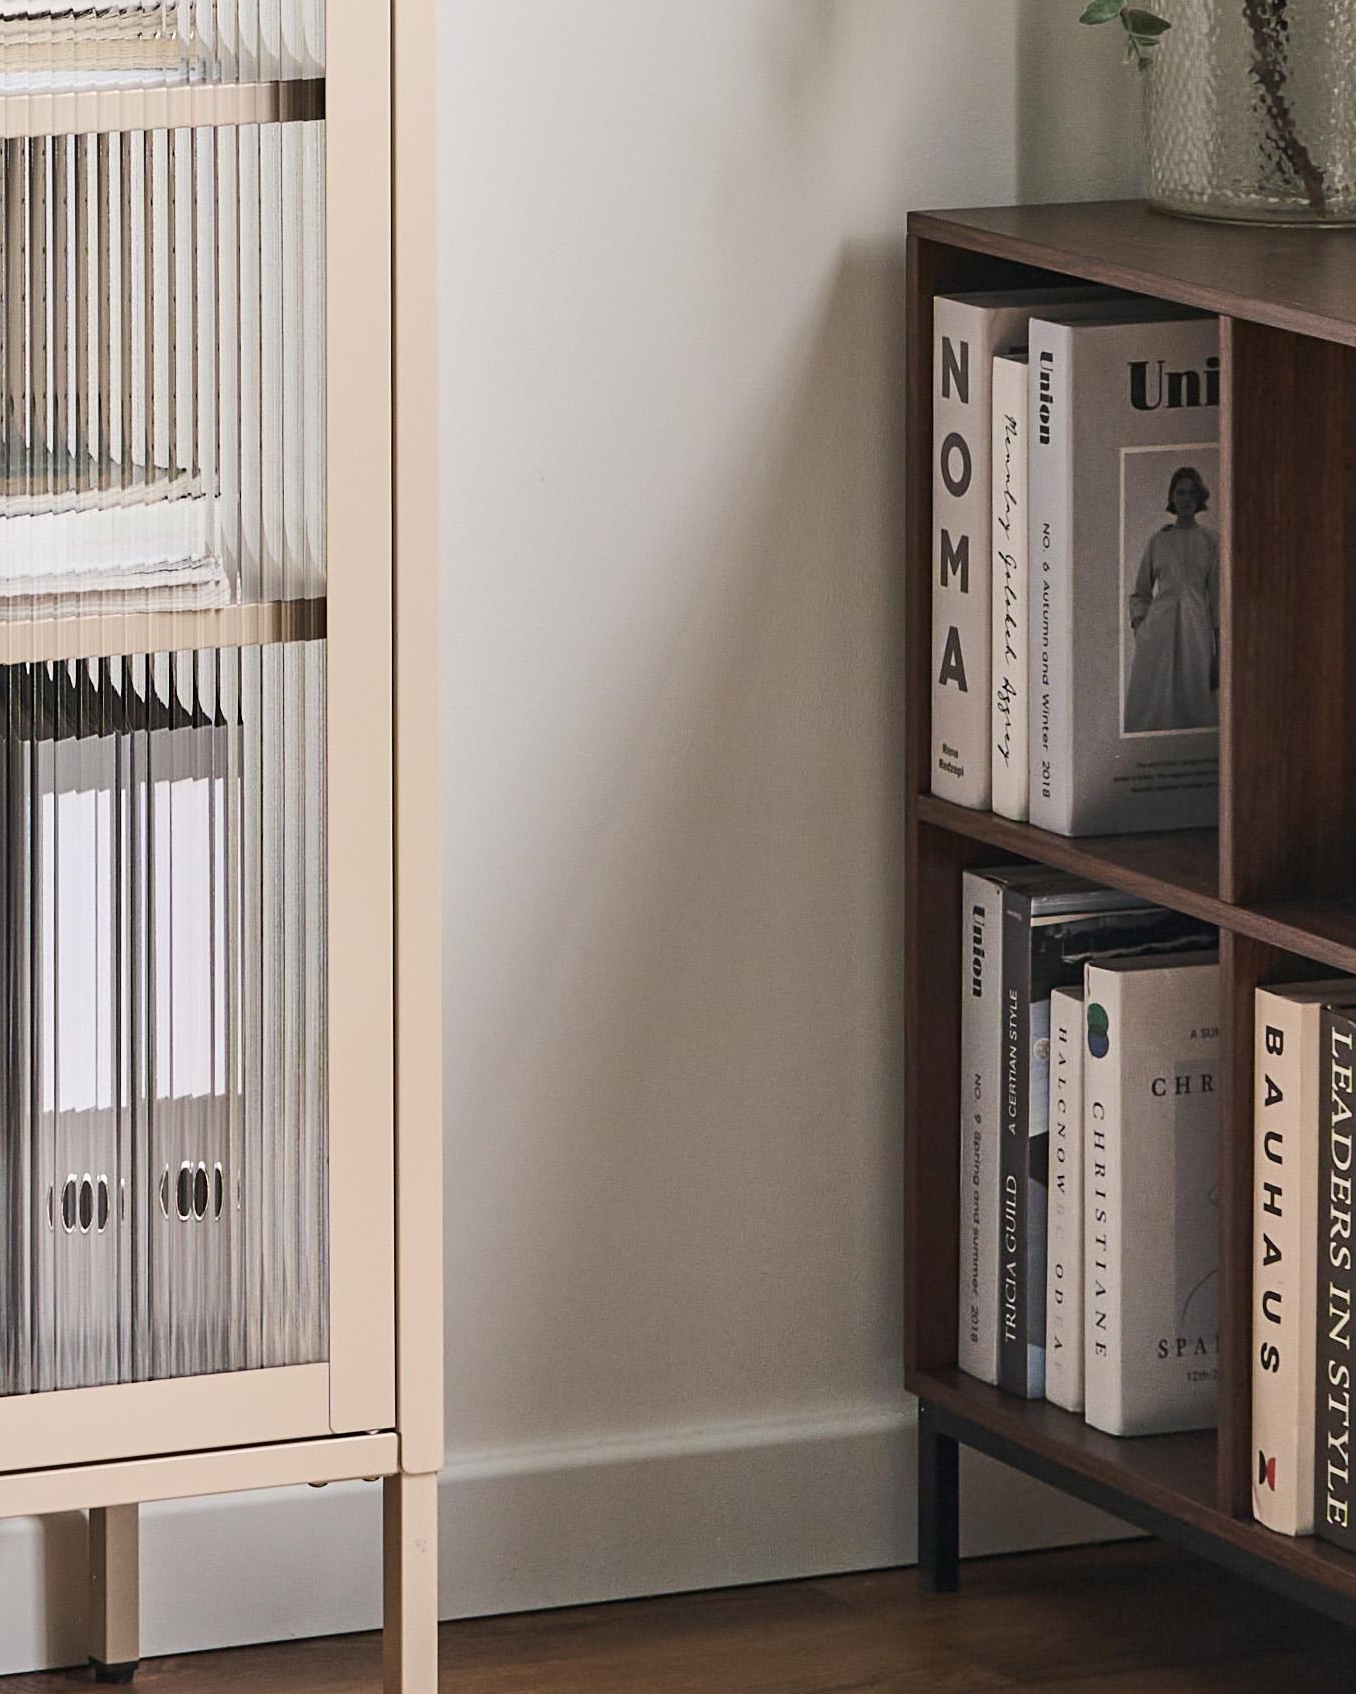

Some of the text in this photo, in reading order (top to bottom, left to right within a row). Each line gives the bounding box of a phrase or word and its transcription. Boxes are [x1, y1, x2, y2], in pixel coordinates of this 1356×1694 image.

[1039, 351, 1054, 445] Union
[1127, 356, 1220, 411] Uni
[939, 335, 972, 693] NOMA
[1042, 561, 1051, 572] 6
[1042, 580, 1051, 647] Autumn
[1042, 651, 1051, 686] and
[1042, 693, 1051, 750] Winter
[1041, 760, 1051, 799] 2018
[972, 905, 986, 998] Union
[1009, 989, 1018, 1041] STYLE
[1151, 1074, 1214, 1097] CHR
[973, 1113, 982, 1125] 9
[1008, 1123, 1016, 1135] A
[972, 1130, 982, 1187] Spring
[972, 1189, 981, 1225] and
[1261, 1025, 1284, 1374] BAUHAUS
[1092, 1101, 1107, 1357] CHRISTIANE
[970, 1227, 979, 1296] summer
[1005, 1175, 1017, 1342] TRICIA GUILD
[1326, 1026, 1353, 1528] LEADERS IN STYLE
[969, 1304, 979, 1344] 2018
